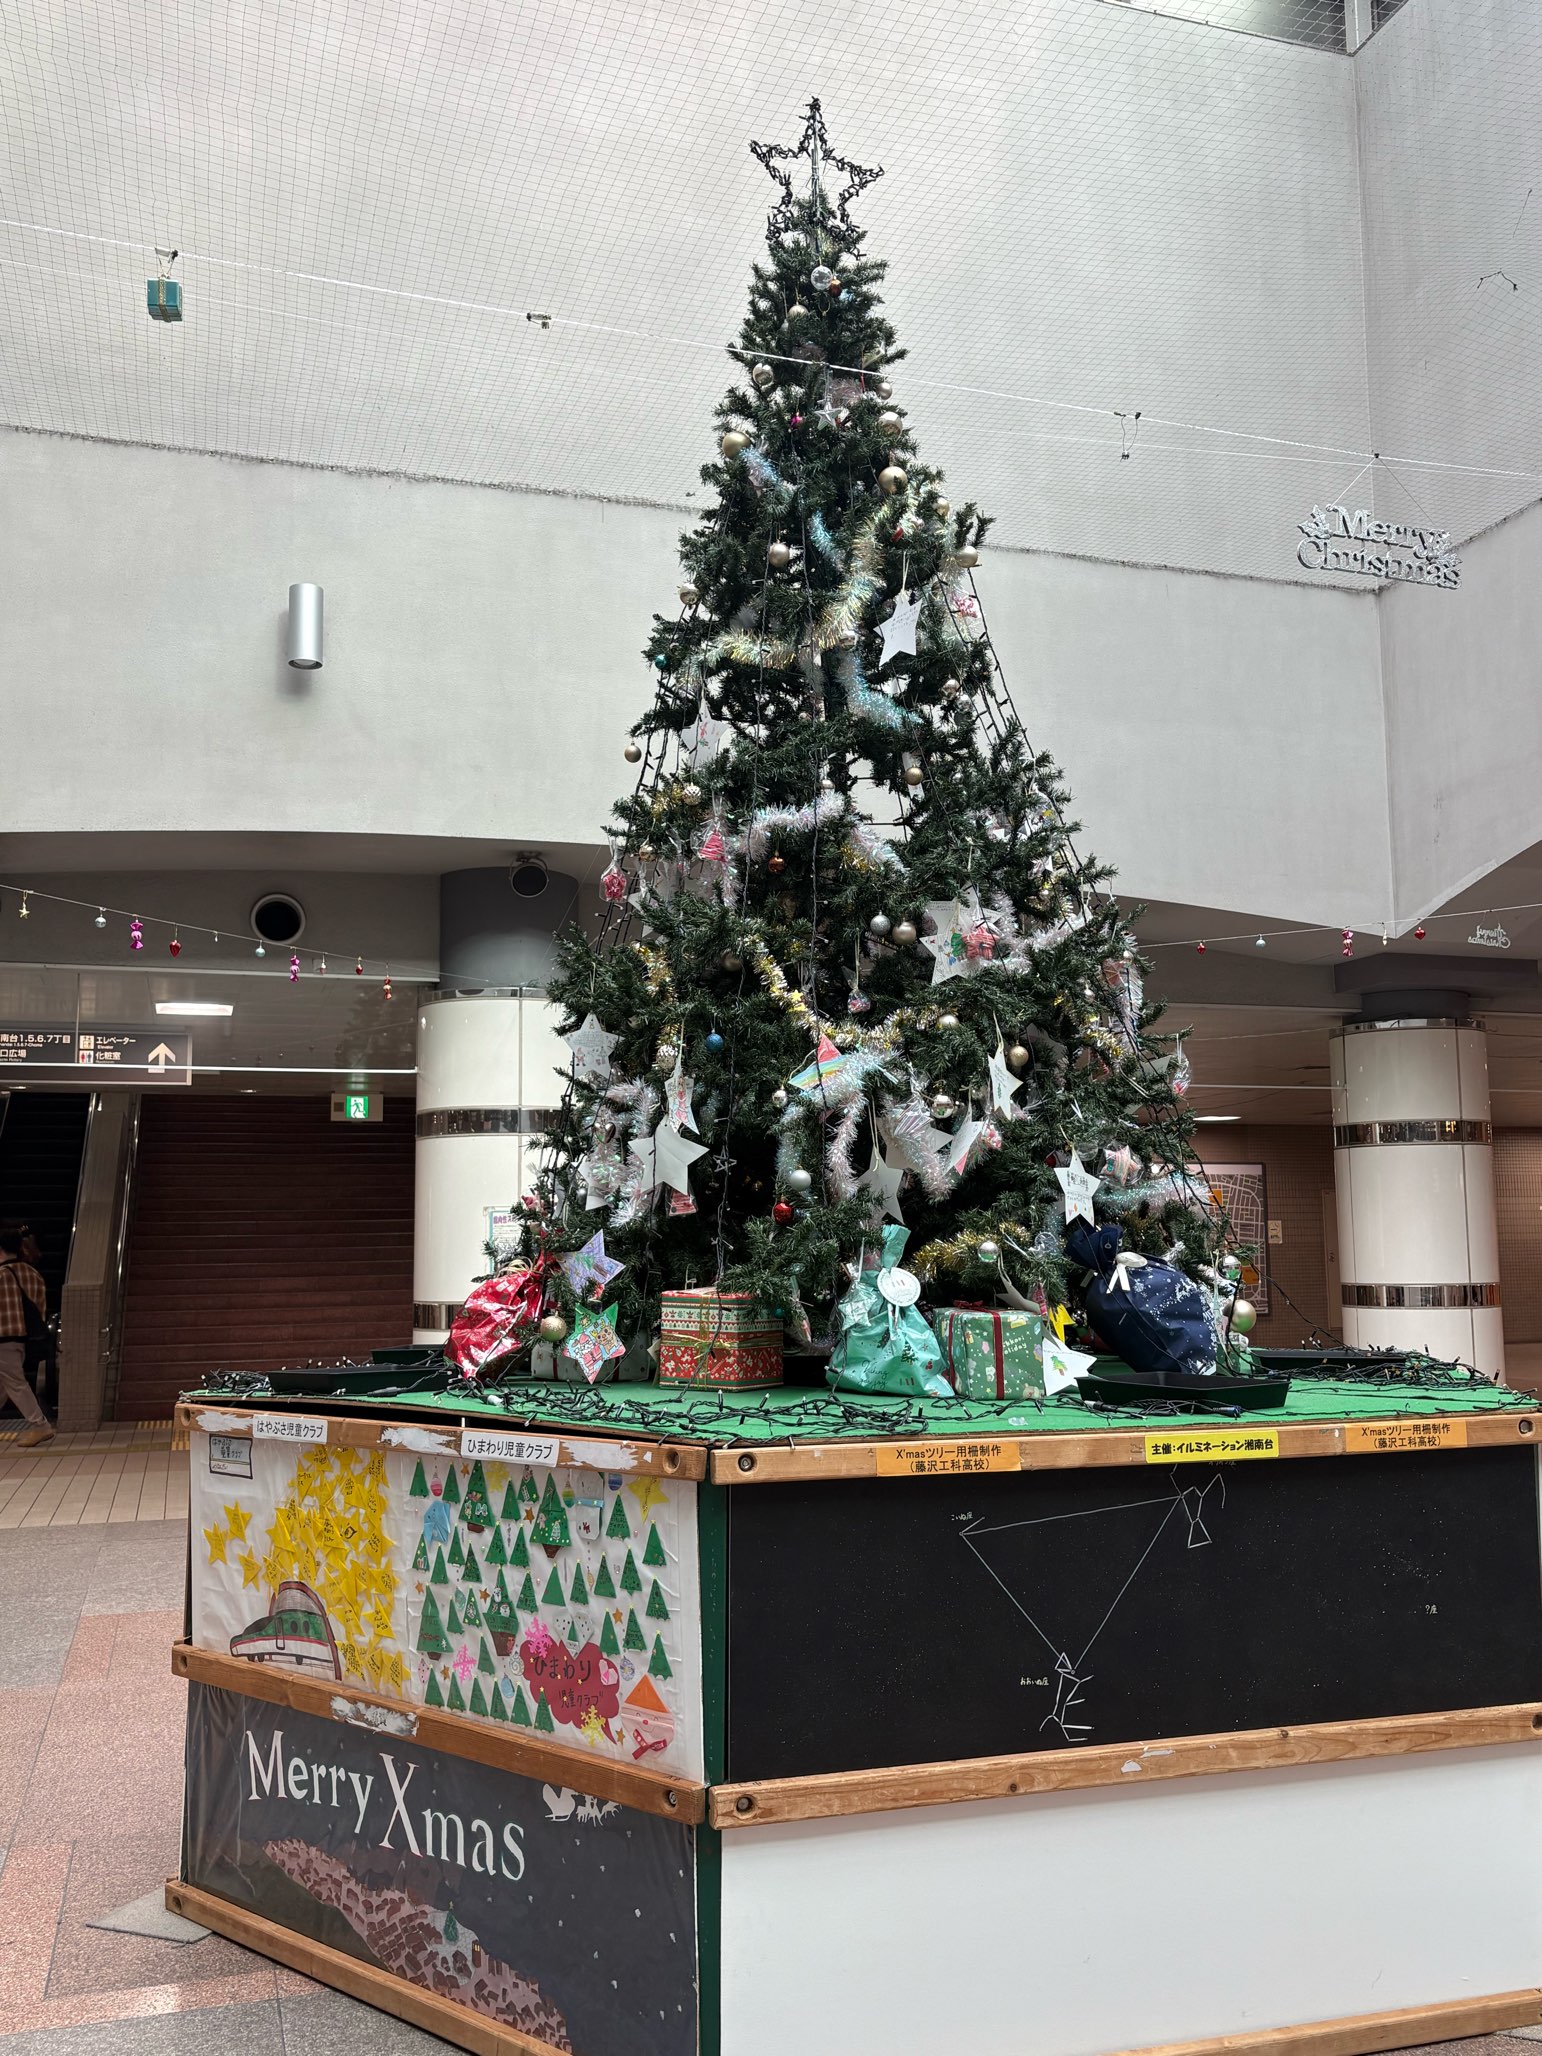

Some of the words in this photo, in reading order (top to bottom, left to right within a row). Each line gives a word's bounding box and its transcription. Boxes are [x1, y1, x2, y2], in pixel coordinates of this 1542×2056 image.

[1329, 505, 1450, 560] Merry
[1297, 537, 1462, 589] Christmas
[96, 1036, 136, 1045] エレベーター
[1003, 1343, 1027, 1355] oliday
[256, 1420, 324, 1439] はやぶさ児童クラブ
[467, 1438, 554, 1460] ひまわり児童クラブ
[1152, 1438, 1274, 1456] 主催：イルミネーション湘南台
[534, 1655, 592, 1682] ひまわり
[246, 1730, 375, 1834] Merry
[378, 1752, 526, 1882] Xmas
